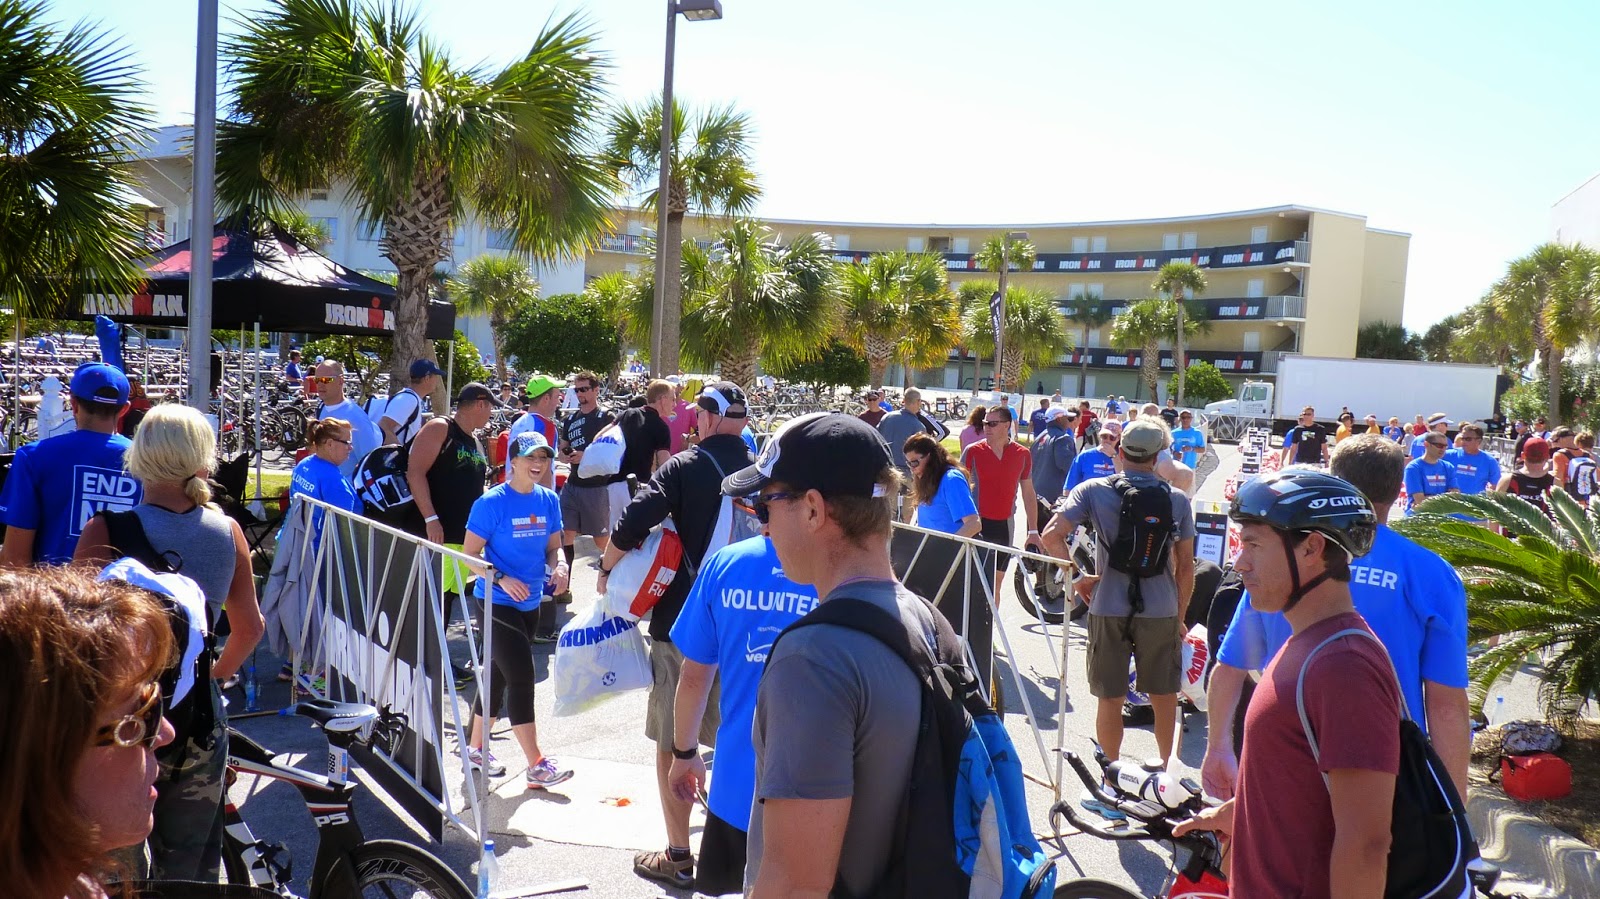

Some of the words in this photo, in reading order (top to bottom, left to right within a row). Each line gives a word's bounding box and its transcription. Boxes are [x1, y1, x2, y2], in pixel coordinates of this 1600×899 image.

[1222, 249, 1263, 264] IRONMAN
[1059, 258, 1101, 269] IRONMAN
[1115, 257, 1156, 269] IRONMAN
[1219, 304, 1259, 316] IRONMAN
[1214, 357, 1254, 369] IRONMAN
[83, 472, 137, 497] END
[1329, 496, 1366, 507] GIRO
[315, 812, 350, 828] P5
